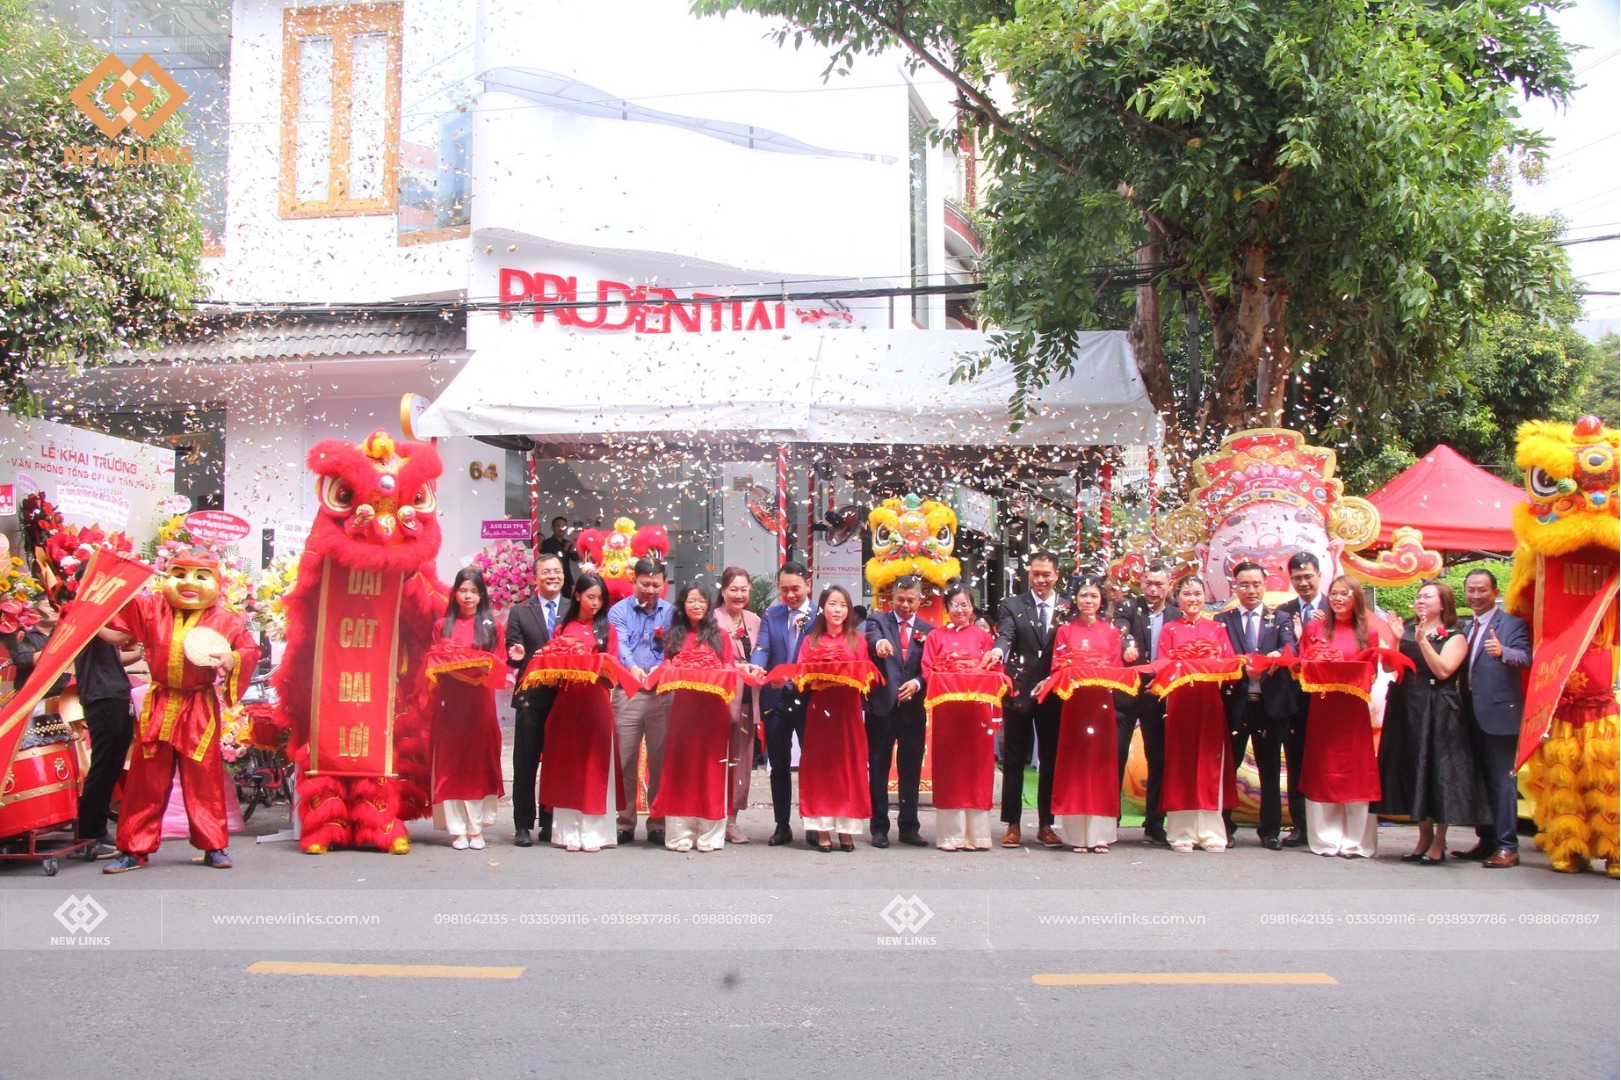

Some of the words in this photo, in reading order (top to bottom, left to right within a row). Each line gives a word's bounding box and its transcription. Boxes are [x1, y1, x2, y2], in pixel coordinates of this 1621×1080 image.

[60, 449, 89, 466] KHAI
[470, 461, 498, 481] 64
[348, 570, 382, 600] ĐẠI
[339, 613, 379, 648] CÁT
[339, 672, 371, 706] ĐẠI
[339, 722, 370, 762] LỢI
